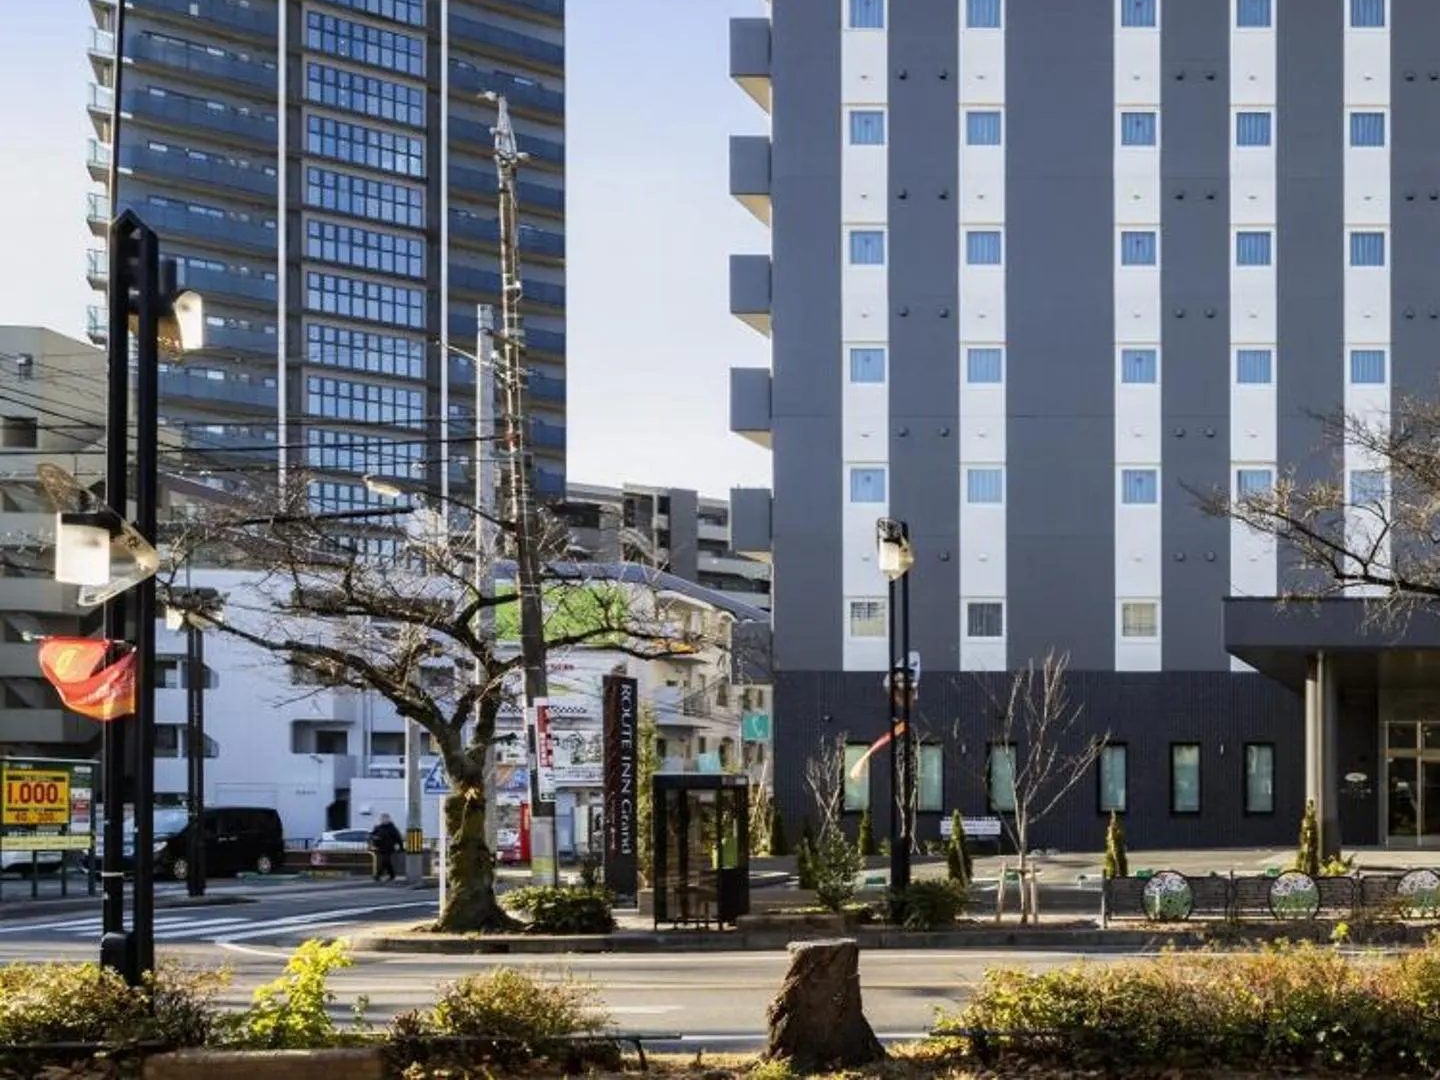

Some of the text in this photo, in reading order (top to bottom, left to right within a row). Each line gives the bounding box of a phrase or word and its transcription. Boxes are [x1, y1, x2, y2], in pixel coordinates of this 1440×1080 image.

[620, 683, 632, 855] ROUTE INN Grand
